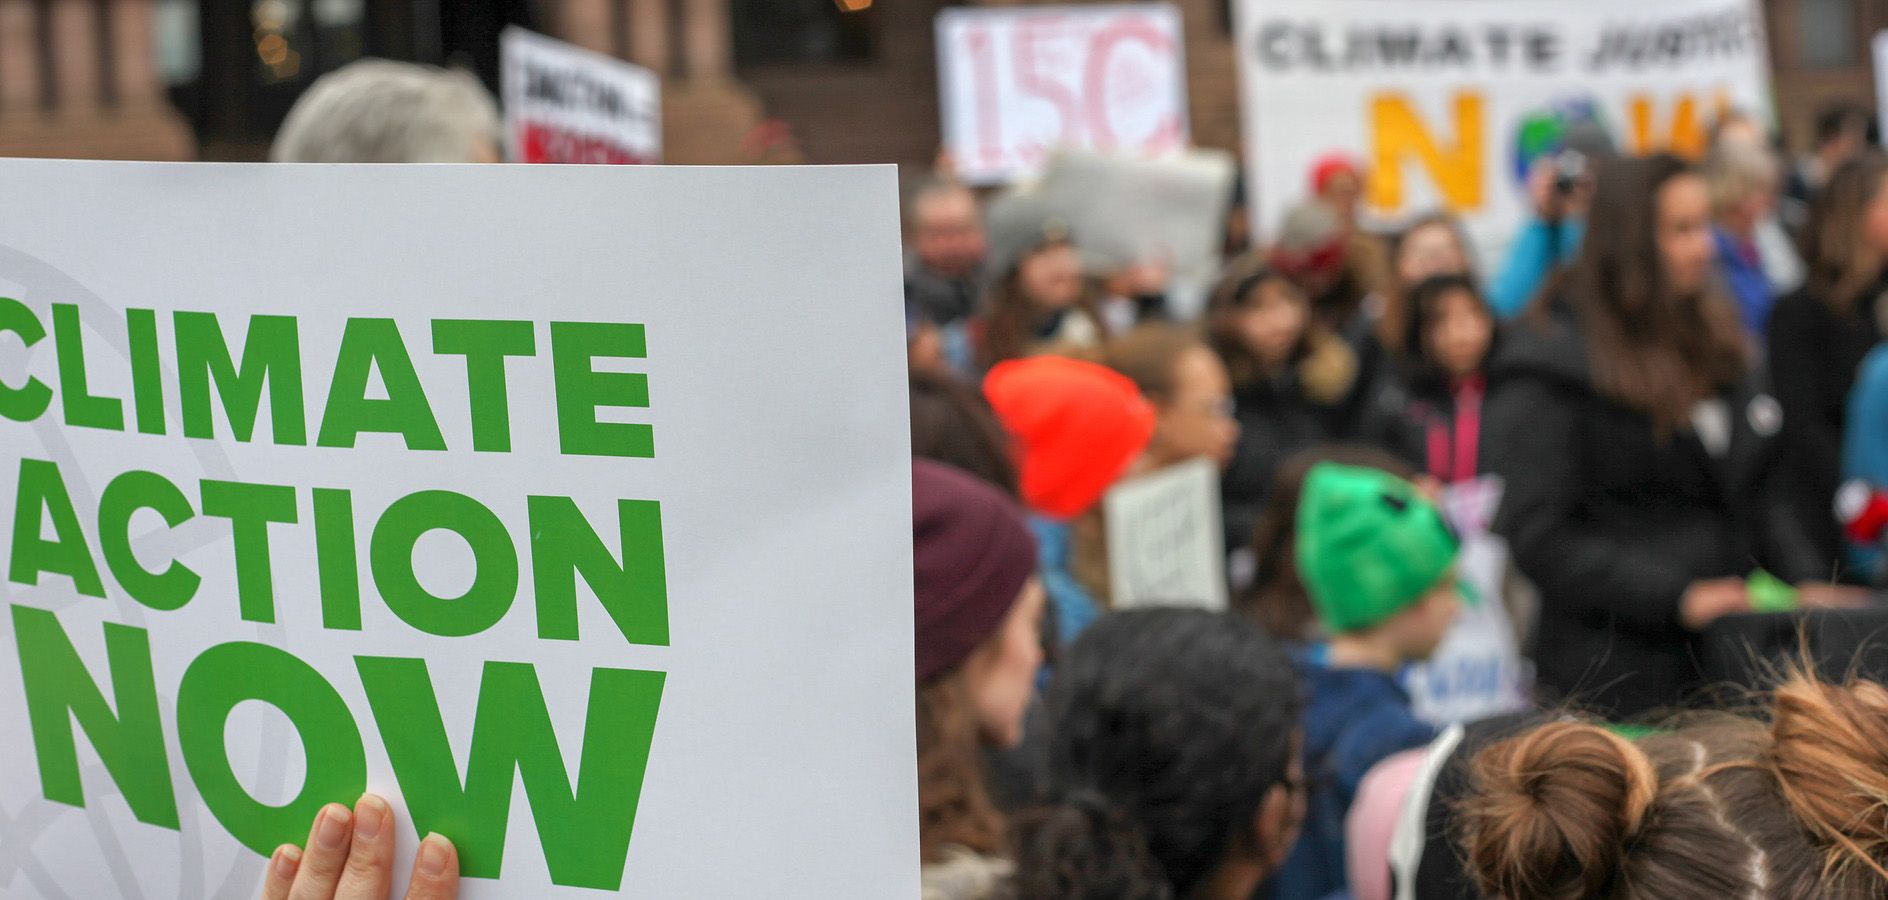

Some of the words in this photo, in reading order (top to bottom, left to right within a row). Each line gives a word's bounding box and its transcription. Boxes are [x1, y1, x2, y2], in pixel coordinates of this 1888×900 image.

[1256, 19, 1561, 73] CLIMATE
[0, 296, 655, 459] CLIMATE
[9, 457, 670, 647] ACTION
[10, 603, 667, 893] NOW
